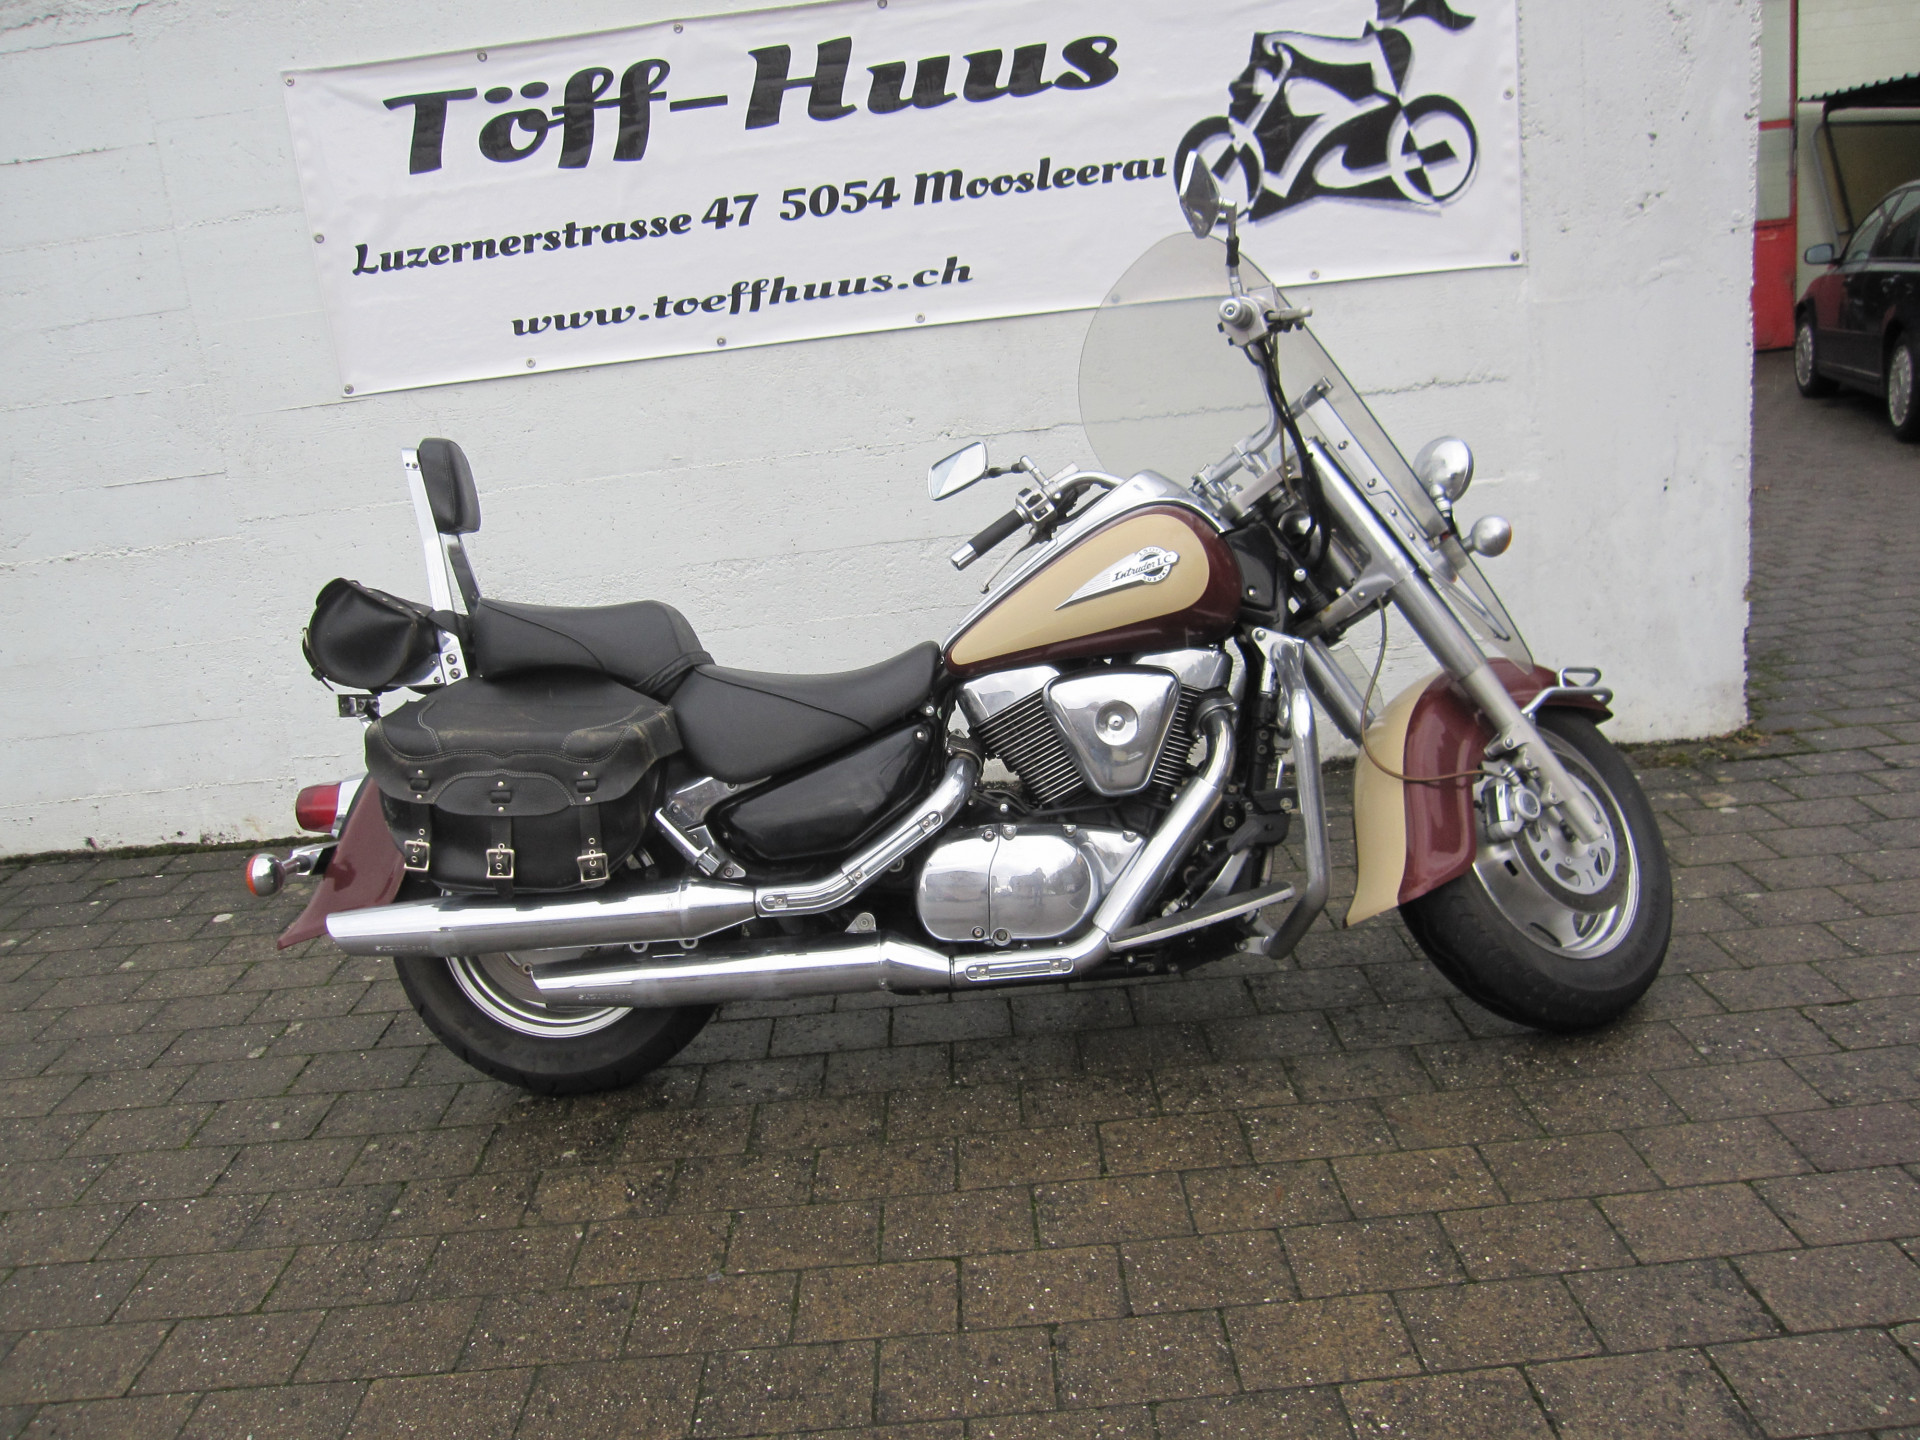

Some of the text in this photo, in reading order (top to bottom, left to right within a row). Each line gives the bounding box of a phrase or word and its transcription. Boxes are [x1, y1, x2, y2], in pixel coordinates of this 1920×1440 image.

[382, 36, 1119, 175] Töff-Huus
[352, 213, 692, 277] Luzernerstrasse
[701, 193, 760, 230] 47
[779, 177, 901, 221] 5054
[511, 256, 973, 337] www.toeffhuus.ch
[1111, 554, 1172, 582] Intruder LC
